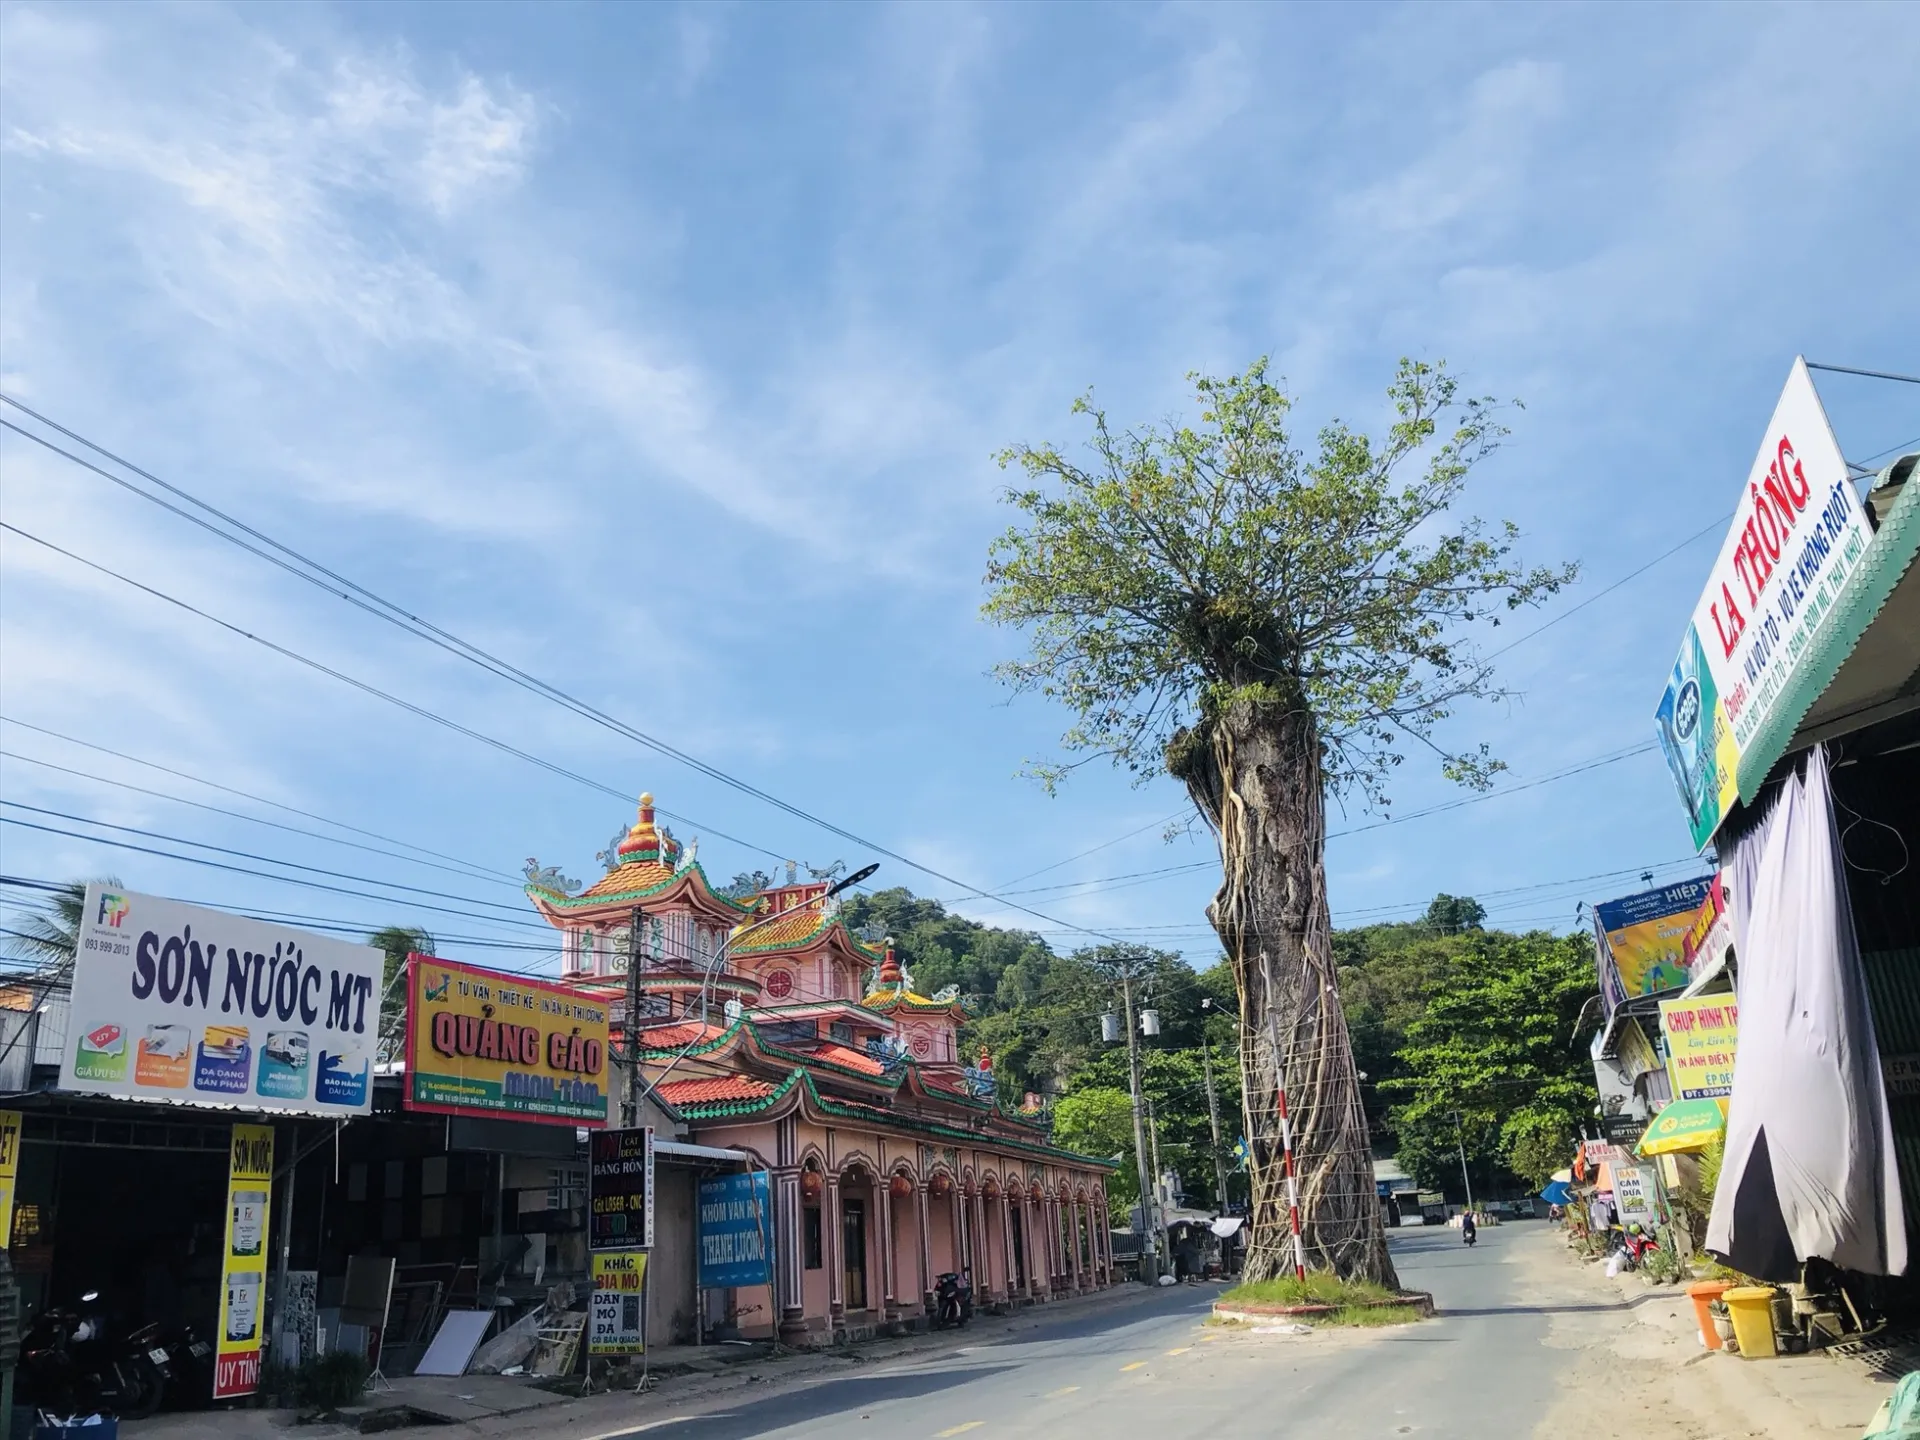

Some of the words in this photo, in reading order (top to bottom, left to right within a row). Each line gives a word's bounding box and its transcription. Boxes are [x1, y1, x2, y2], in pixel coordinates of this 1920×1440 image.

[1822, 480, 1852, 543] RUỘT
[1710, 581, 1747, 662] LA
[1733, 434, 1811, 613] THÔNG
[1796, 523, 1831, 590] KHÔNG
[1787, 568, 1804, 608] XE
[1826, 553, 1848, 599] THAY
[1777, 579, 1795, 624] VỎ
[1758, 625, 1771, 658] Ô
[1764, 607, 1780, 648] TÔ
[1664, 884, 1699, 902] HIỆP
[99, 941, 112, 953] 999
[131, 924, 217, 1010] SƠN
[221, 941, 321, 1026] NƯỚC
[325, 969, 372, 1034] MT
[457, 980, 470, 997] TƯ
[472, 979, 491, 1001] VẤN
[498, 987, 521, 1006] THIẾT
[523, 990, 537, 1010] KẾ
[541, 999, 550, 1014] IN
[551, 996, 563, 1016] ẤN
[564, 1003, 570, 1017] &
[572, 1005, 586, 1021] THI
[586, 1006, 605, 1024] CÔNG
[1667, 1010, 1697, 1037] CHỤP
[1696, 1003, 1725, 1030] HÌNH
[432, 1004, 540, 1065] QUẢNG
[548, 1027, 603, 1076] CÁO
[1677, 1057, 1688, 1069] IN
[1688, 1052, 1707, 1068] ẢNH
[1708, 1051, 1730, 1068] ĐIỆN
[233, 1137, 250, 1174] SƠN
[251, 1133, 271, 1174] NƯỚC
[629, 1194, 643, 1211] CNC
[702, 1198, 727, 1224] KHÓM
[728, 1197, 745, 1221] VĂN
[604, 1253, 635, 1270] KHẮC
[702, 1233, 734, 1266] THANH
[596, 1273, 618, 1290] BIA
[621, 1269, 640, 1292] MỘ
[594, 1292, 621, 1305] DÁN
[597, 1319, 615, 1334] ĐÁ
[218, 1365, 238, 1388] UY
